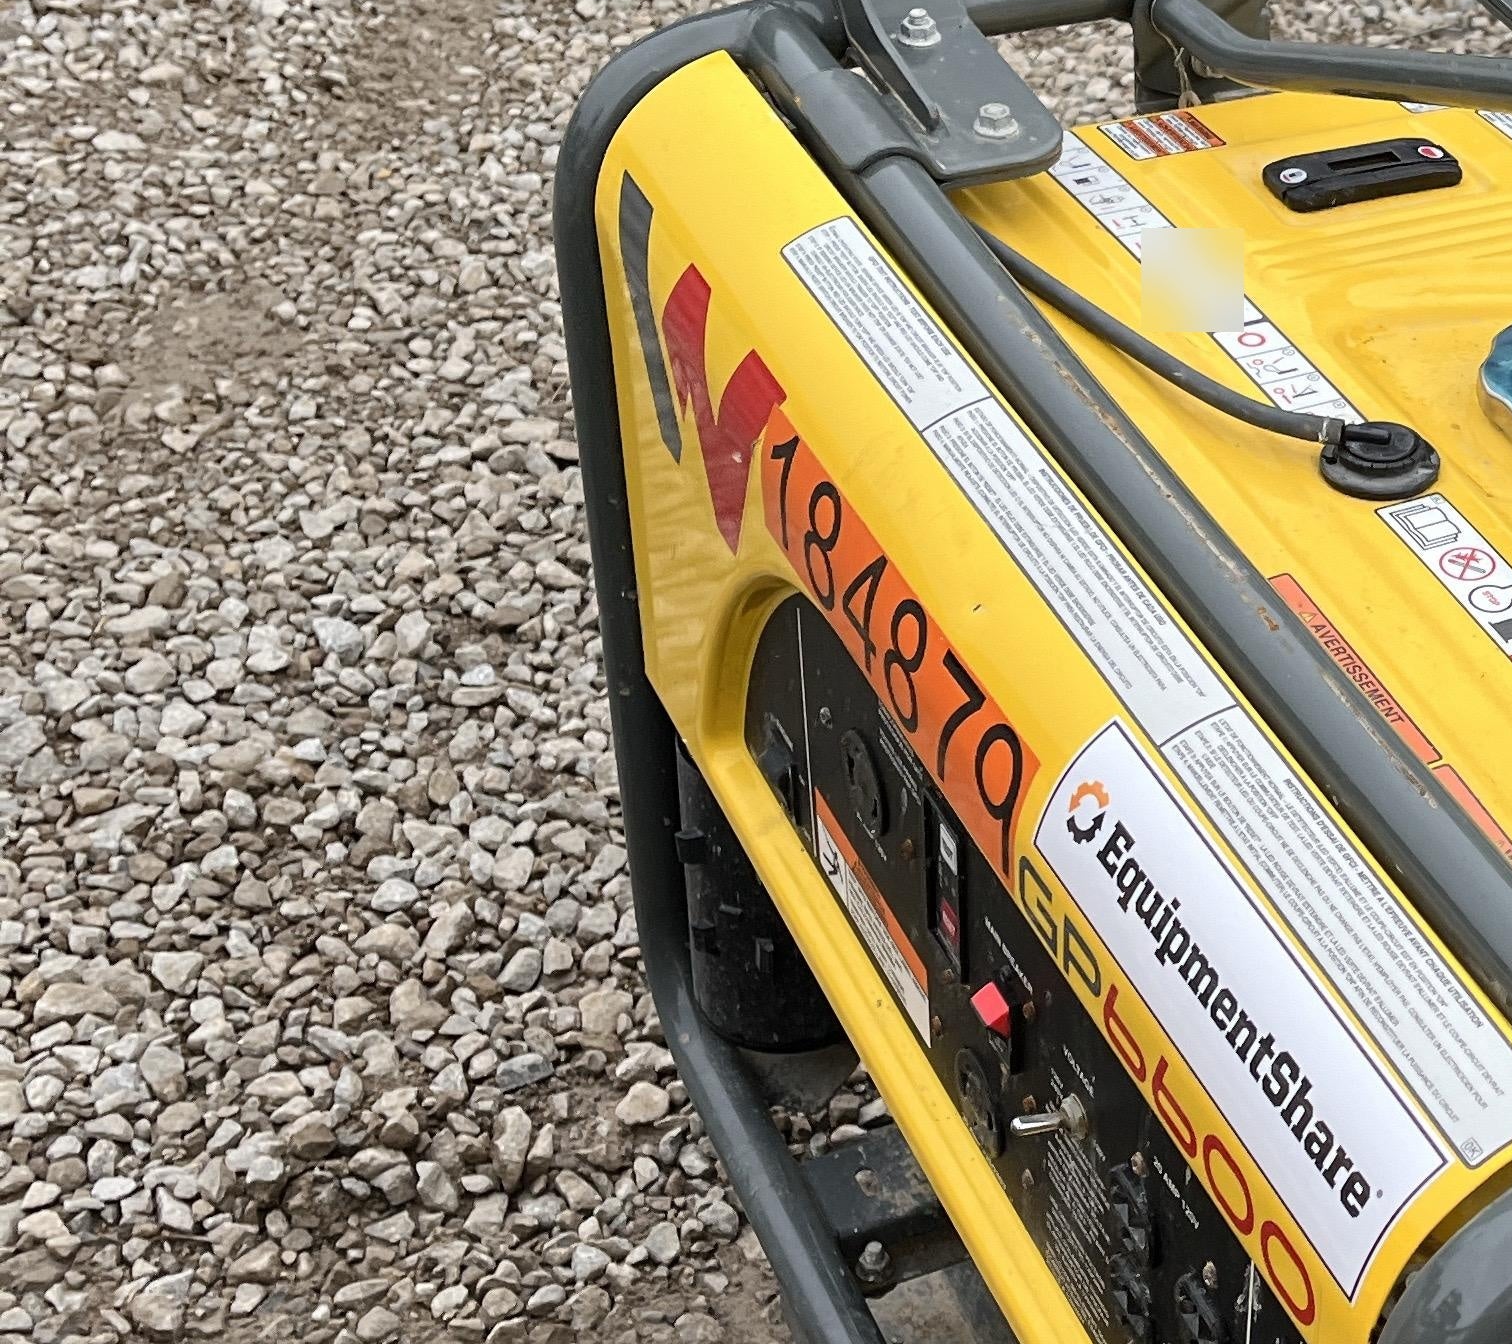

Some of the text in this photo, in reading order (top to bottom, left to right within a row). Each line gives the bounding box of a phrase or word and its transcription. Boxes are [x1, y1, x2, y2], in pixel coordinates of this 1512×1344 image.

[768, 435, 1024, 880] 184879
[1309, 621, 1405, 726] AVERTISSEMENT
[1481, 590, 1500, 606] STOP
[1017, 854, 1317, 1327] GP6600
[1098, 820, 1371, 1219] EquipmentShare
